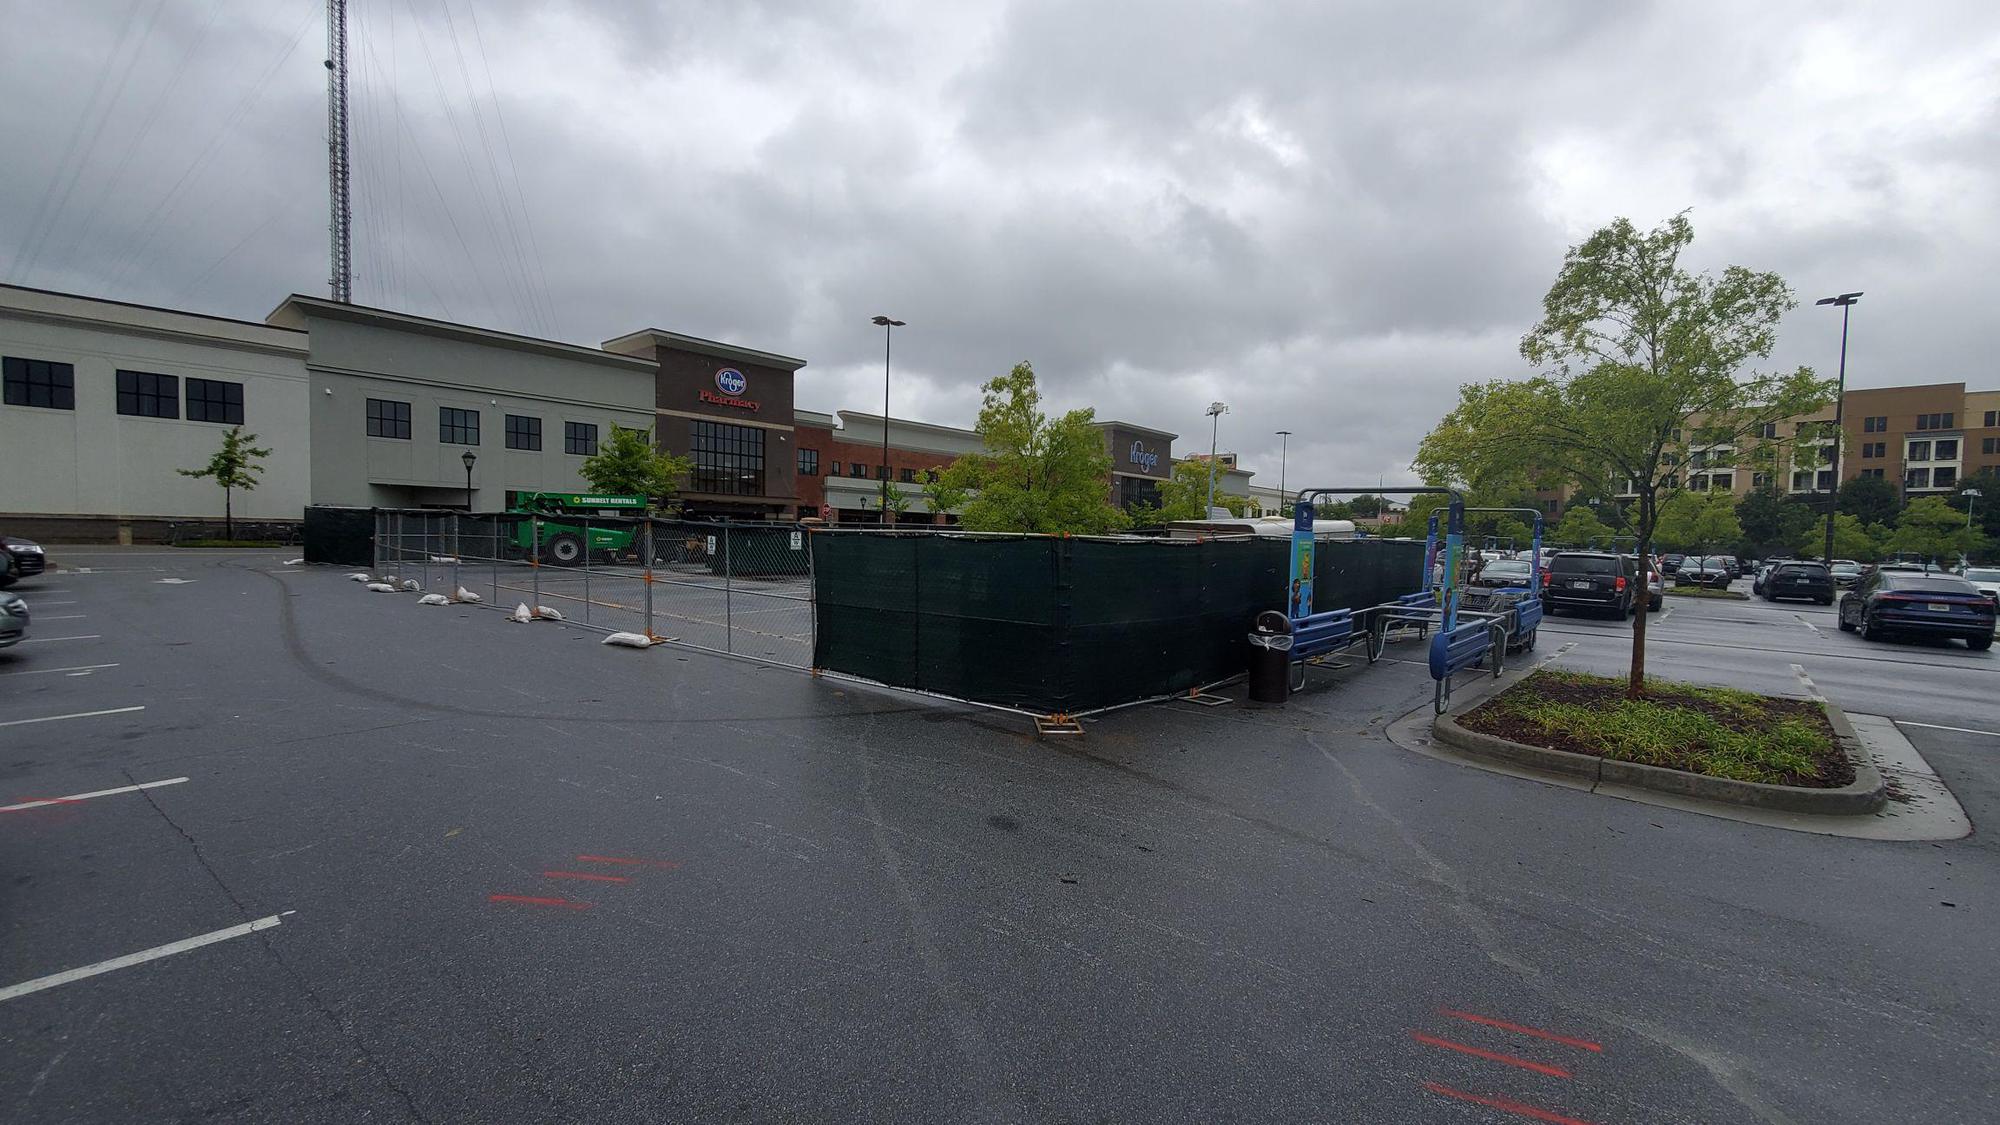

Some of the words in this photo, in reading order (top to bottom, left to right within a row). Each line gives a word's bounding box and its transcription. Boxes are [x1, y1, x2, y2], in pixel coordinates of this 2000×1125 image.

[721, 372, 744, 392] Kroger
[699, 390, 760, 412] Pharmacy
[1131, 441, 1158, 473] Kroger
